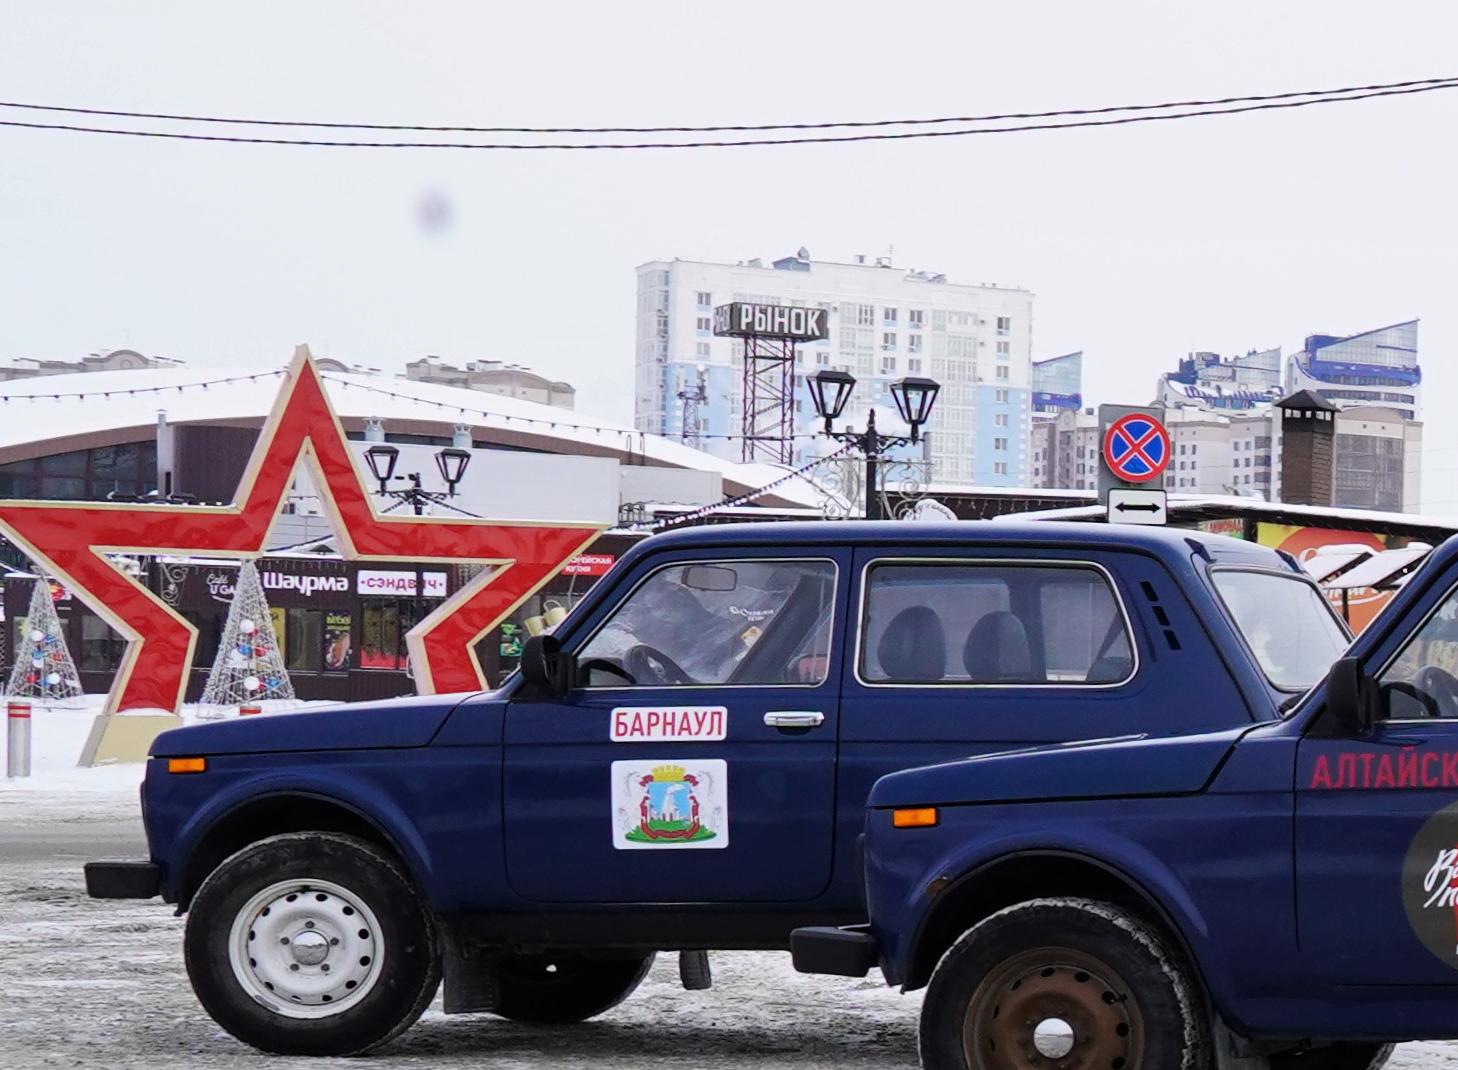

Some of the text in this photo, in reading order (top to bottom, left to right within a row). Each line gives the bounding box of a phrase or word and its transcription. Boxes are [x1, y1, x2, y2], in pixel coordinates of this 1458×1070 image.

[740, 303, 822, 337] РЫНОК
[262, 571, 350, 597] Шаурма
[614, 711, 723, 737] БАРНАУЛ
